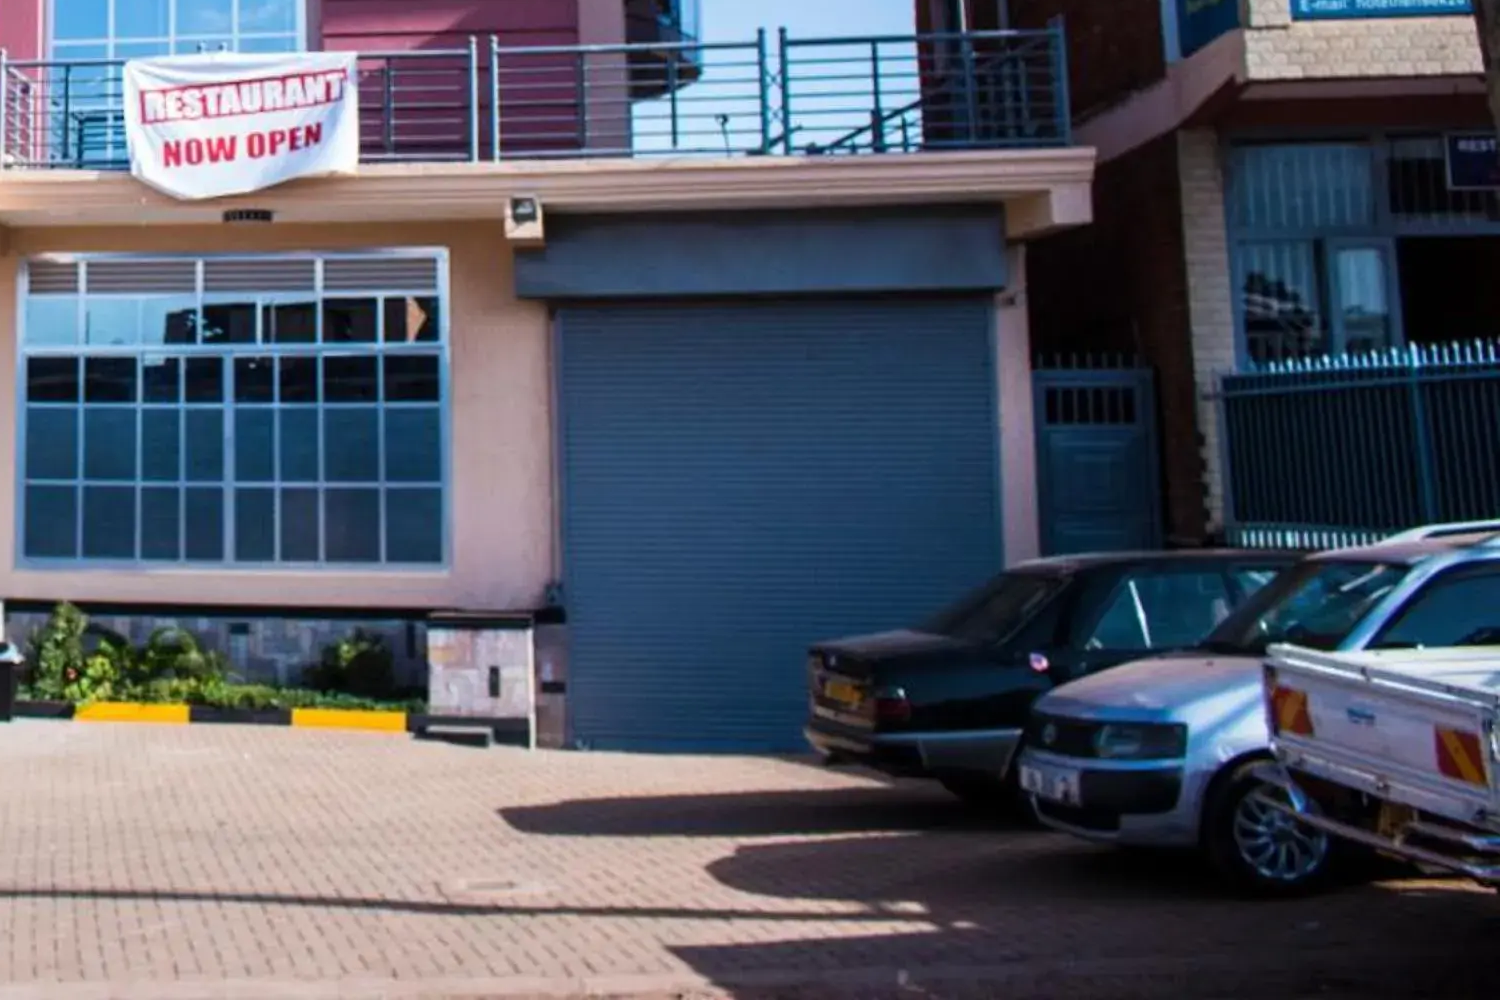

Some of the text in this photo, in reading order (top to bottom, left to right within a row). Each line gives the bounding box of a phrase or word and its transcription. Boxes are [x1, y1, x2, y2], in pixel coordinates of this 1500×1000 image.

[143, 72, 345, 121] RESTAURANT
[163, 122, 323, 168] NOW OPEN
